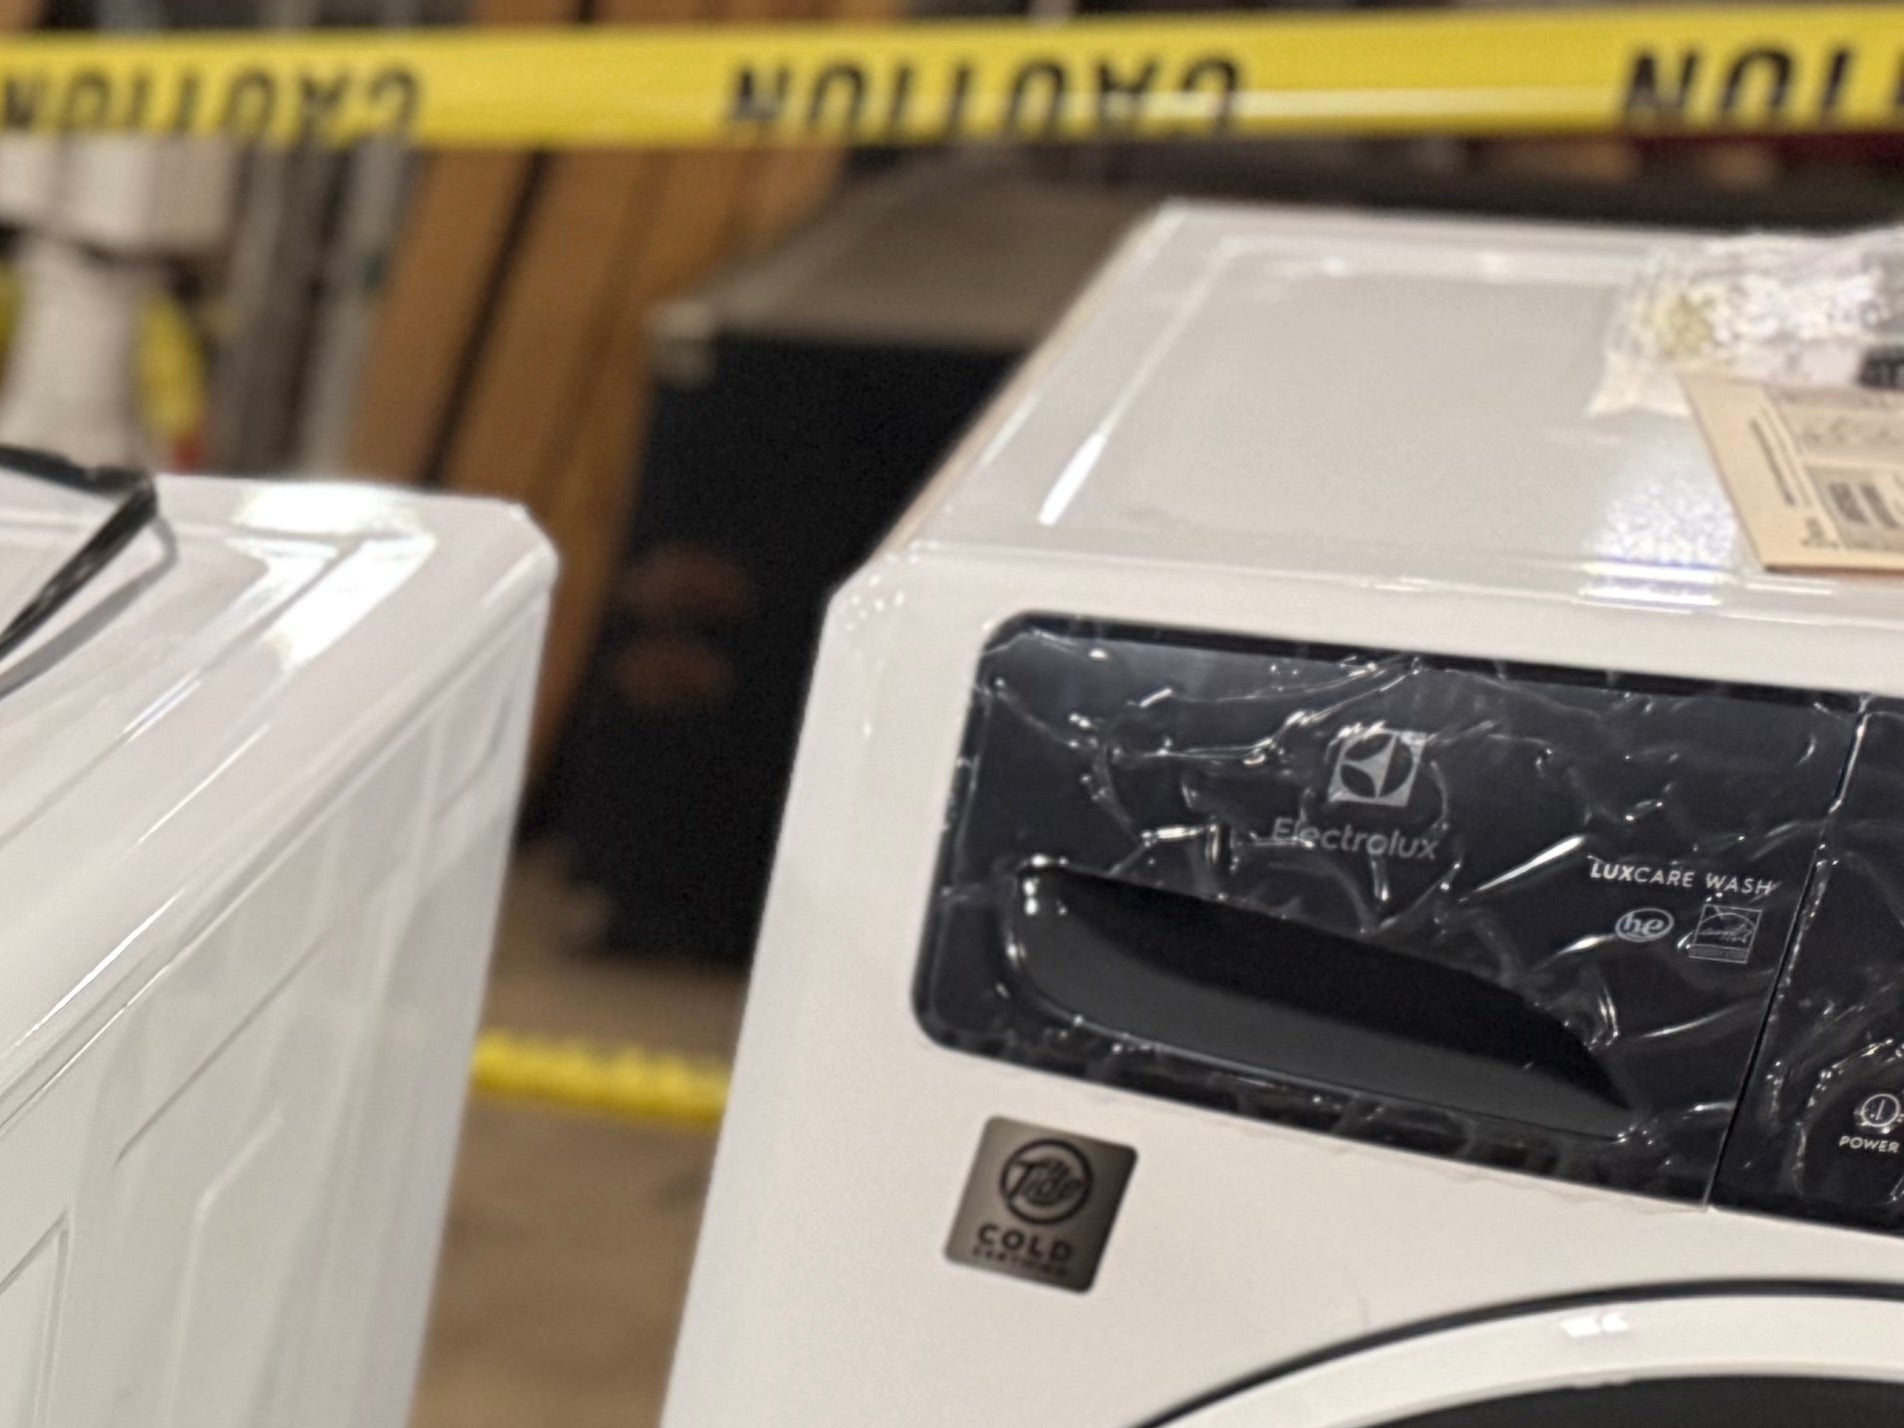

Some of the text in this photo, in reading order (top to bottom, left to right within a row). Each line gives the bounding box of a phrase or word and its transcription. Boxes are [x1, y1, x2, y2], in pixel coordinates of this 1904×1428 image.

[730, 55, 1242, 140] CAUTION
[1272, 816, 1440, 861] Electrolux
[1590, 863, 1773, 896] LUXCARE WASH
[1839, 1135, 1900, 1154] POWER
[978, 1221, 1074, 1263] COLD
